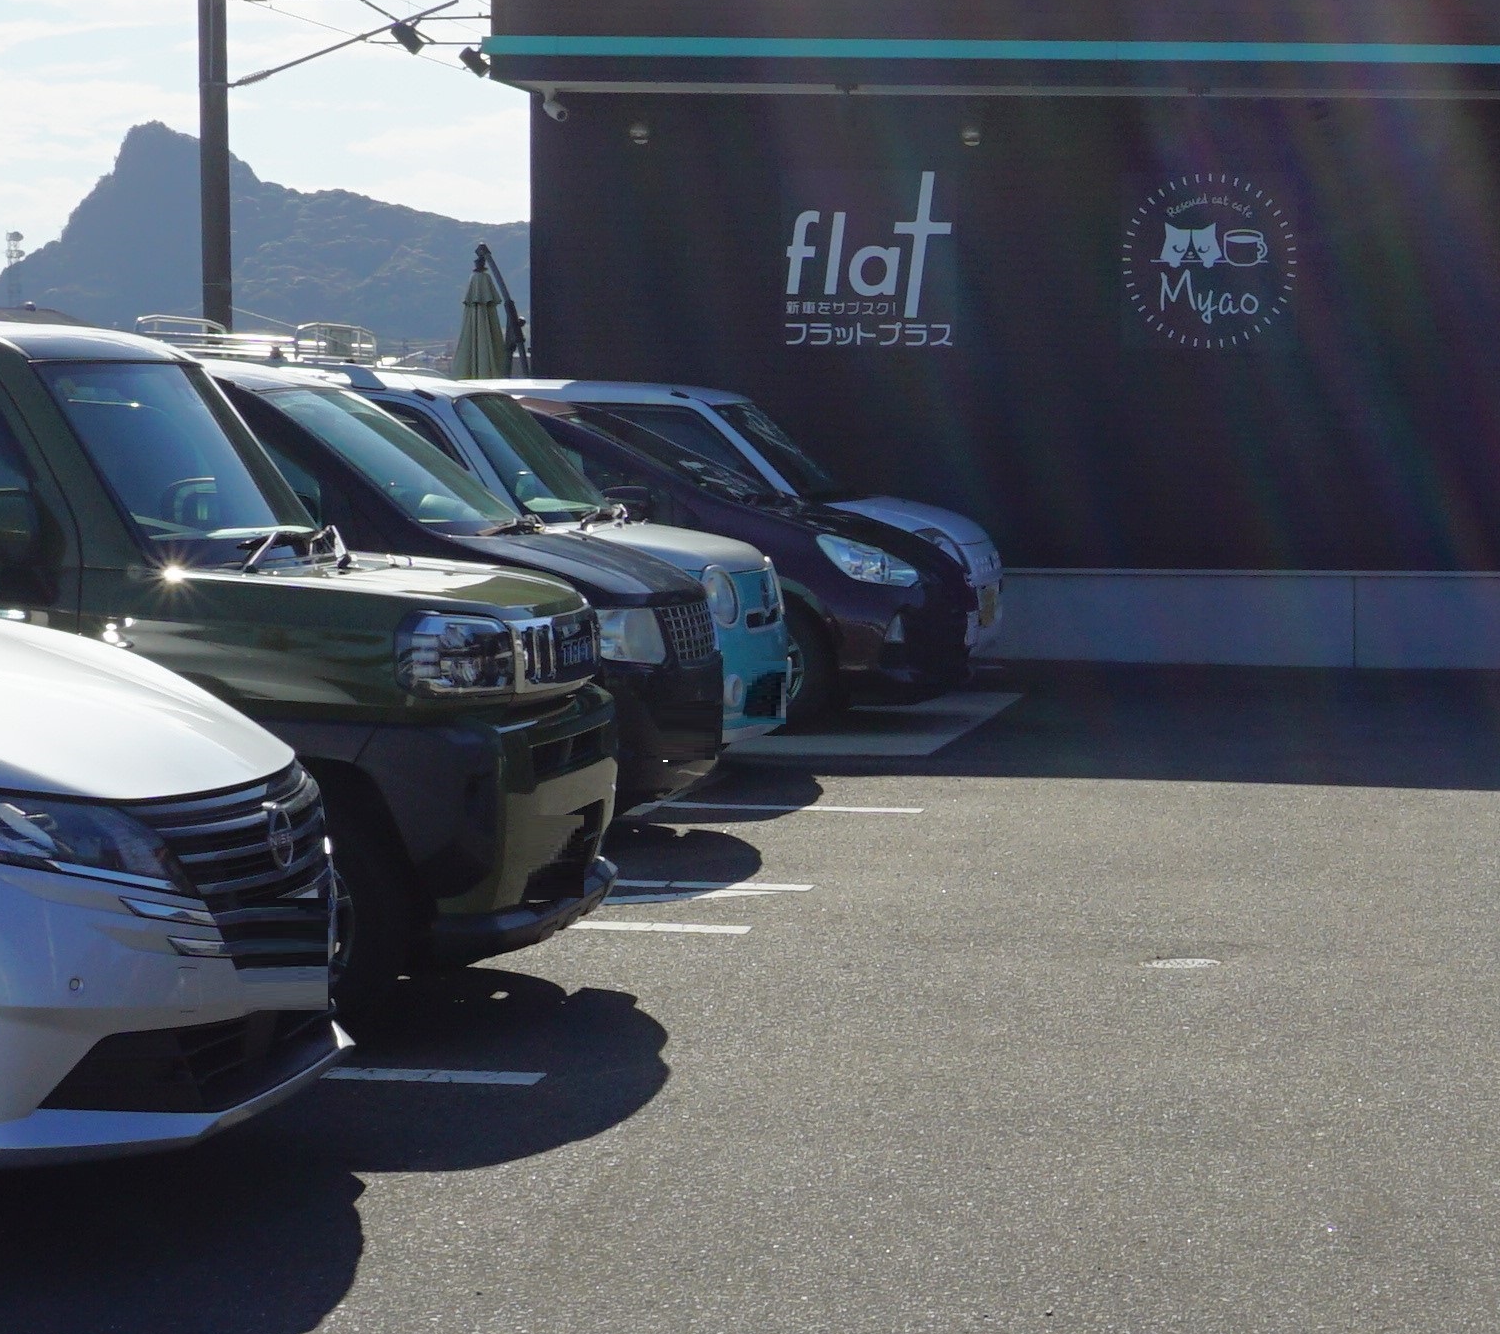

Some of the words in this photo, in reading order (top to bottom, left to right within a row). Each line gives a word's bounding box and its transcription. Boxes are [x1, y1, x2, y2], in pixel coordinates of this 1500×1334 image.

[1211, 195, 1230, 205] cat
[785, 170, 953, 319] flat
[1159, 268, 1260, 325] Myao
[784, 321, 953, 347] フラットプラス
